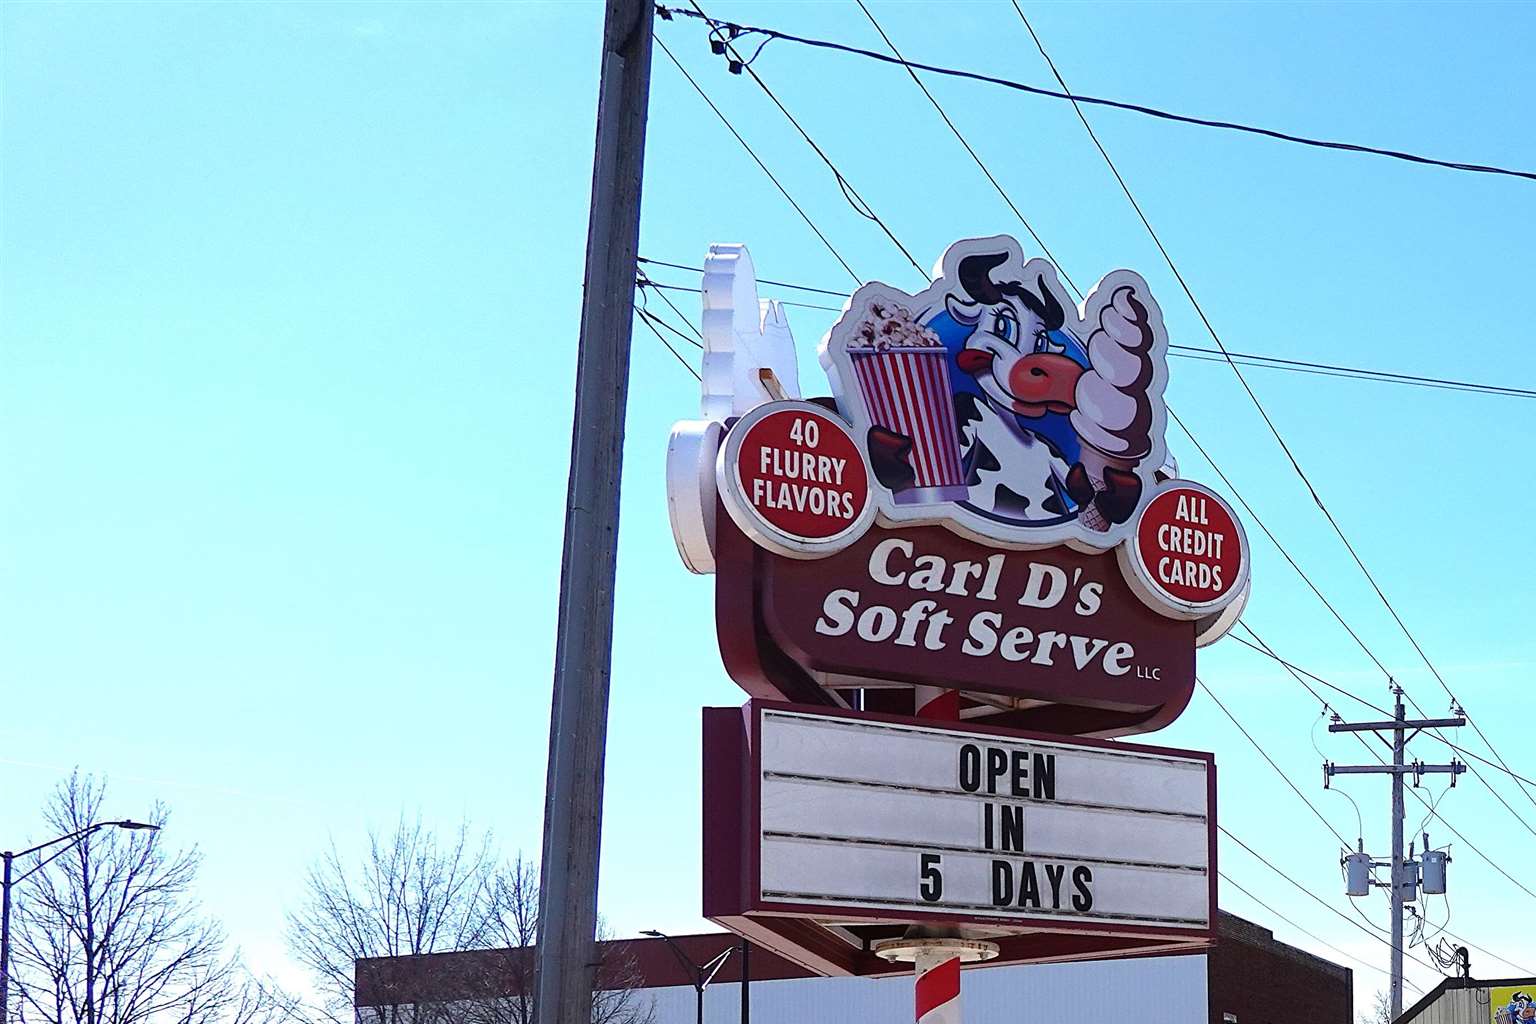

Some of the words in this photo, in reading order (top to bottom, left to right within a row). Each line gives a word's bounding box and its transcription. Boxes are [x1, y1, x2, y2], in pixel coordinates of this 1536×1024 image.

[789, 418, 820, 449] 40
[760, 448, 846, 485] FLURRY
[754, 478, 854, 520] FLAVORS
[1175, 495, 1209, 525] ALL
[1158, 525, 1224, 560] CREDIT
[868, 538, 1006, 602] Carl
[1017, 563, 1104, 617] D's
[1158, 559, 1223, 592] CARDS
[814, 588, 953, 651] Soft
[961, 610, 1136, 677] Serve
[1136, 666, 1161, 681] LLC
[958, 743, 1056, 800] OPEN
[984, 802, 1025, 852] IN
[920, 853, 943, 903] 5
[992, 859, 1093, 912] DAYS
